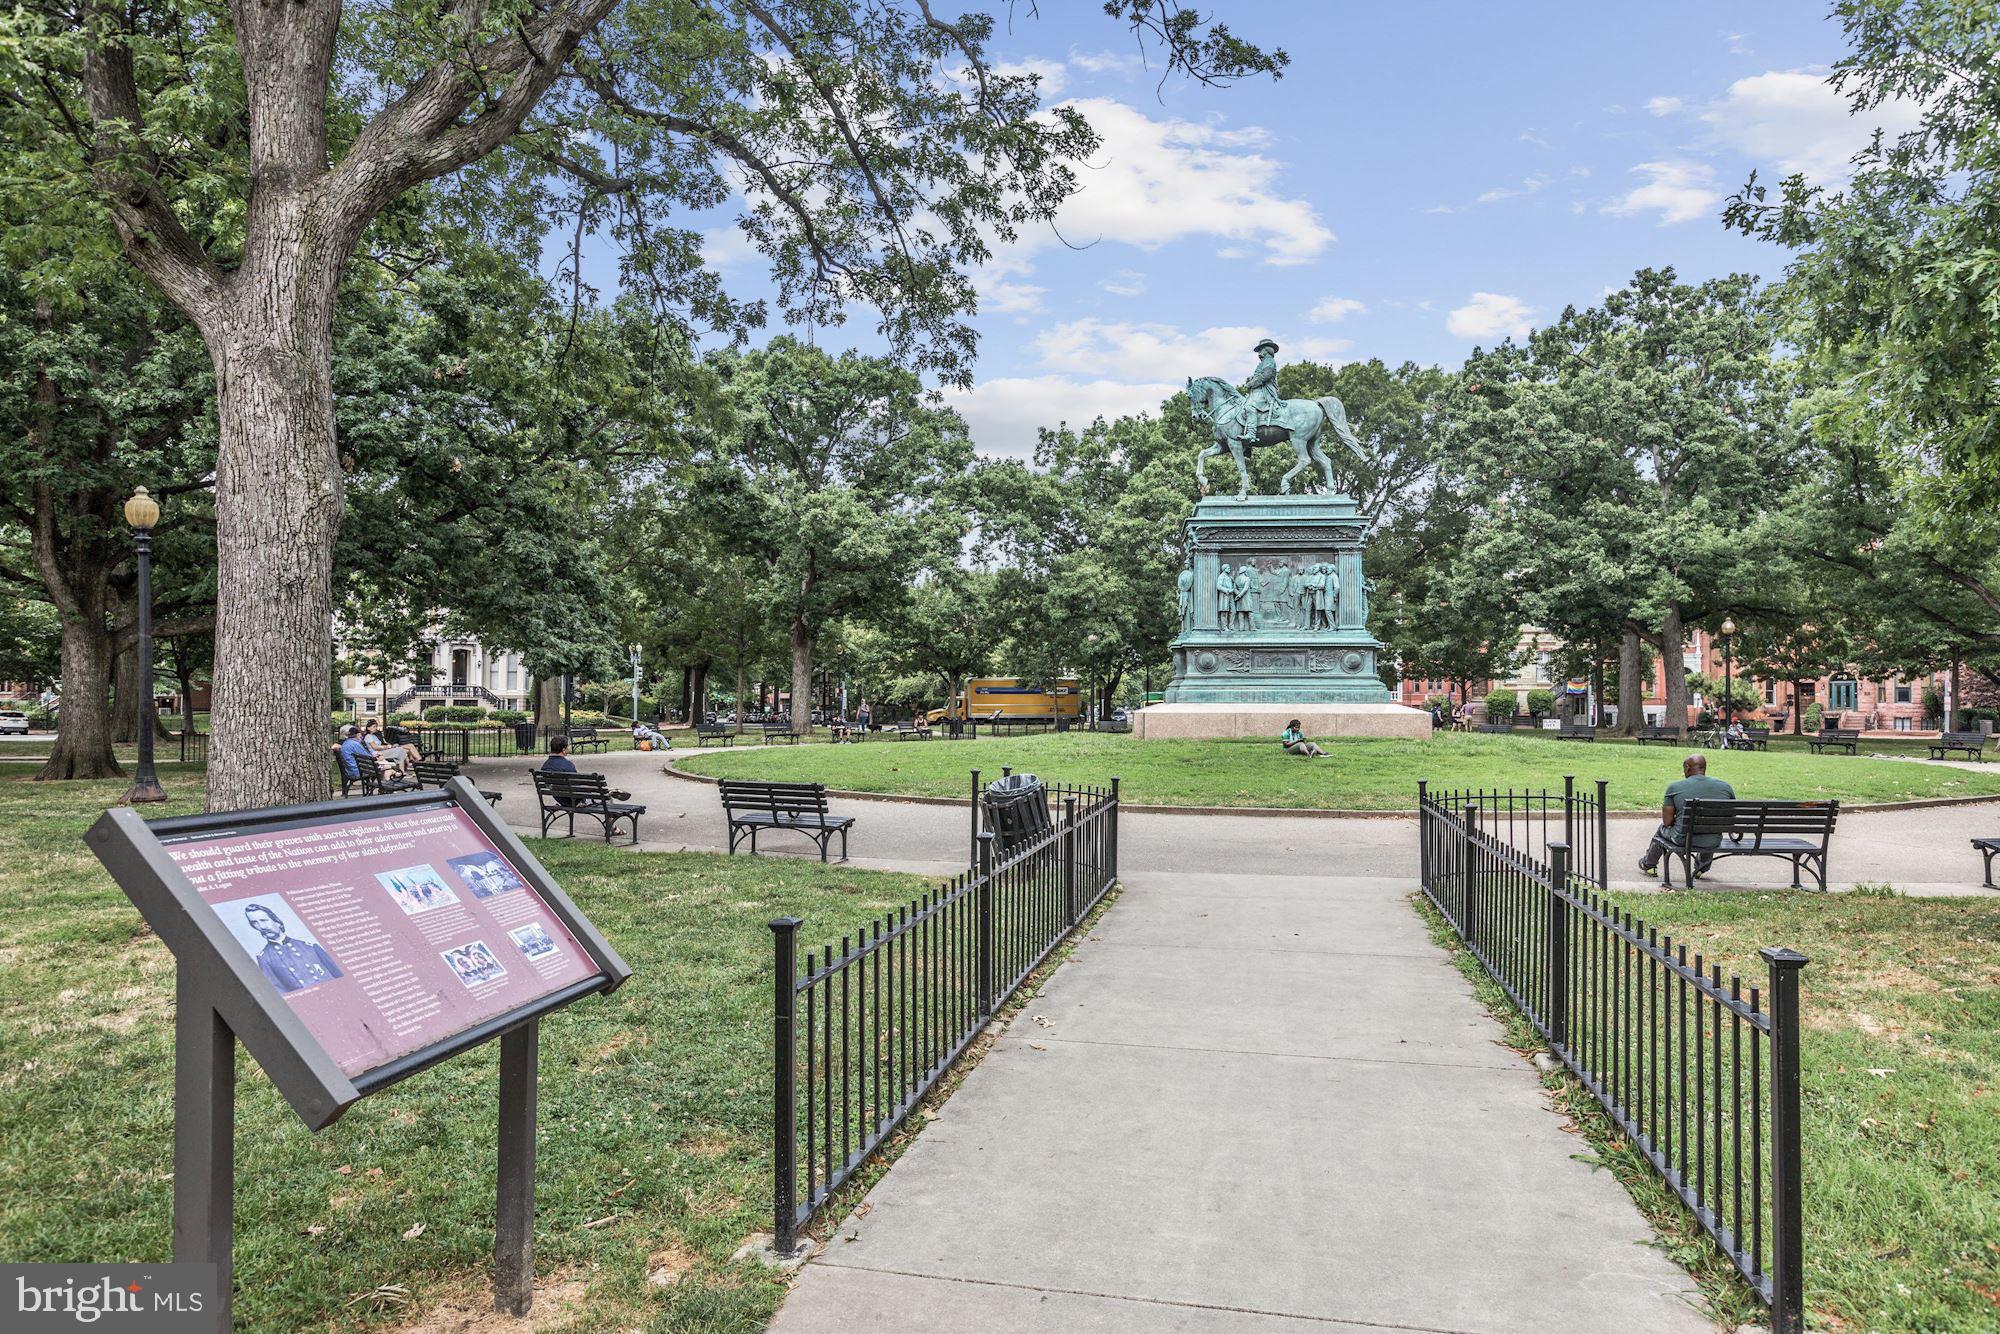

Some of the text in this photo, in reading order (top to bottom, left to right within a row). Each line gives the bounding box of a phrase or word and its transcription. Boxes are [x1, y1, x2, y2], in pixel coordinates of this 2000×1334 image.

[168, 852, 187, 860] We
[189, 846, 222, 858] should
[223, 842, 251, 856] guard
[252, 840, 272, 849] their
[275, 837, 303, 848] graves
[303, 833, 322, 842] with
[323, 829, 348, 839] sacred
[420, 814, 455, 824] consecrated
[214, 857, 234, 867] and
[234, 856, 257, 864] taste
[258, 852, 268, 862] of
[268, 851, 283, 859] the
[282, 847, 313, 856] Nation
[330, 841, 346, 849] add
[355, 837, 372, 845] their
[375, 831, 413, 842] adornment
[413, 828, 427, 836] and
[215, 870, 247, 882] fitting
[246, 865, 277, 874] tribute
[288, 860, 302, 868] the
[303, 856, 337, 865] memory
[338, 851, 347, 862] of
[362, 847, 380, 856] slain
